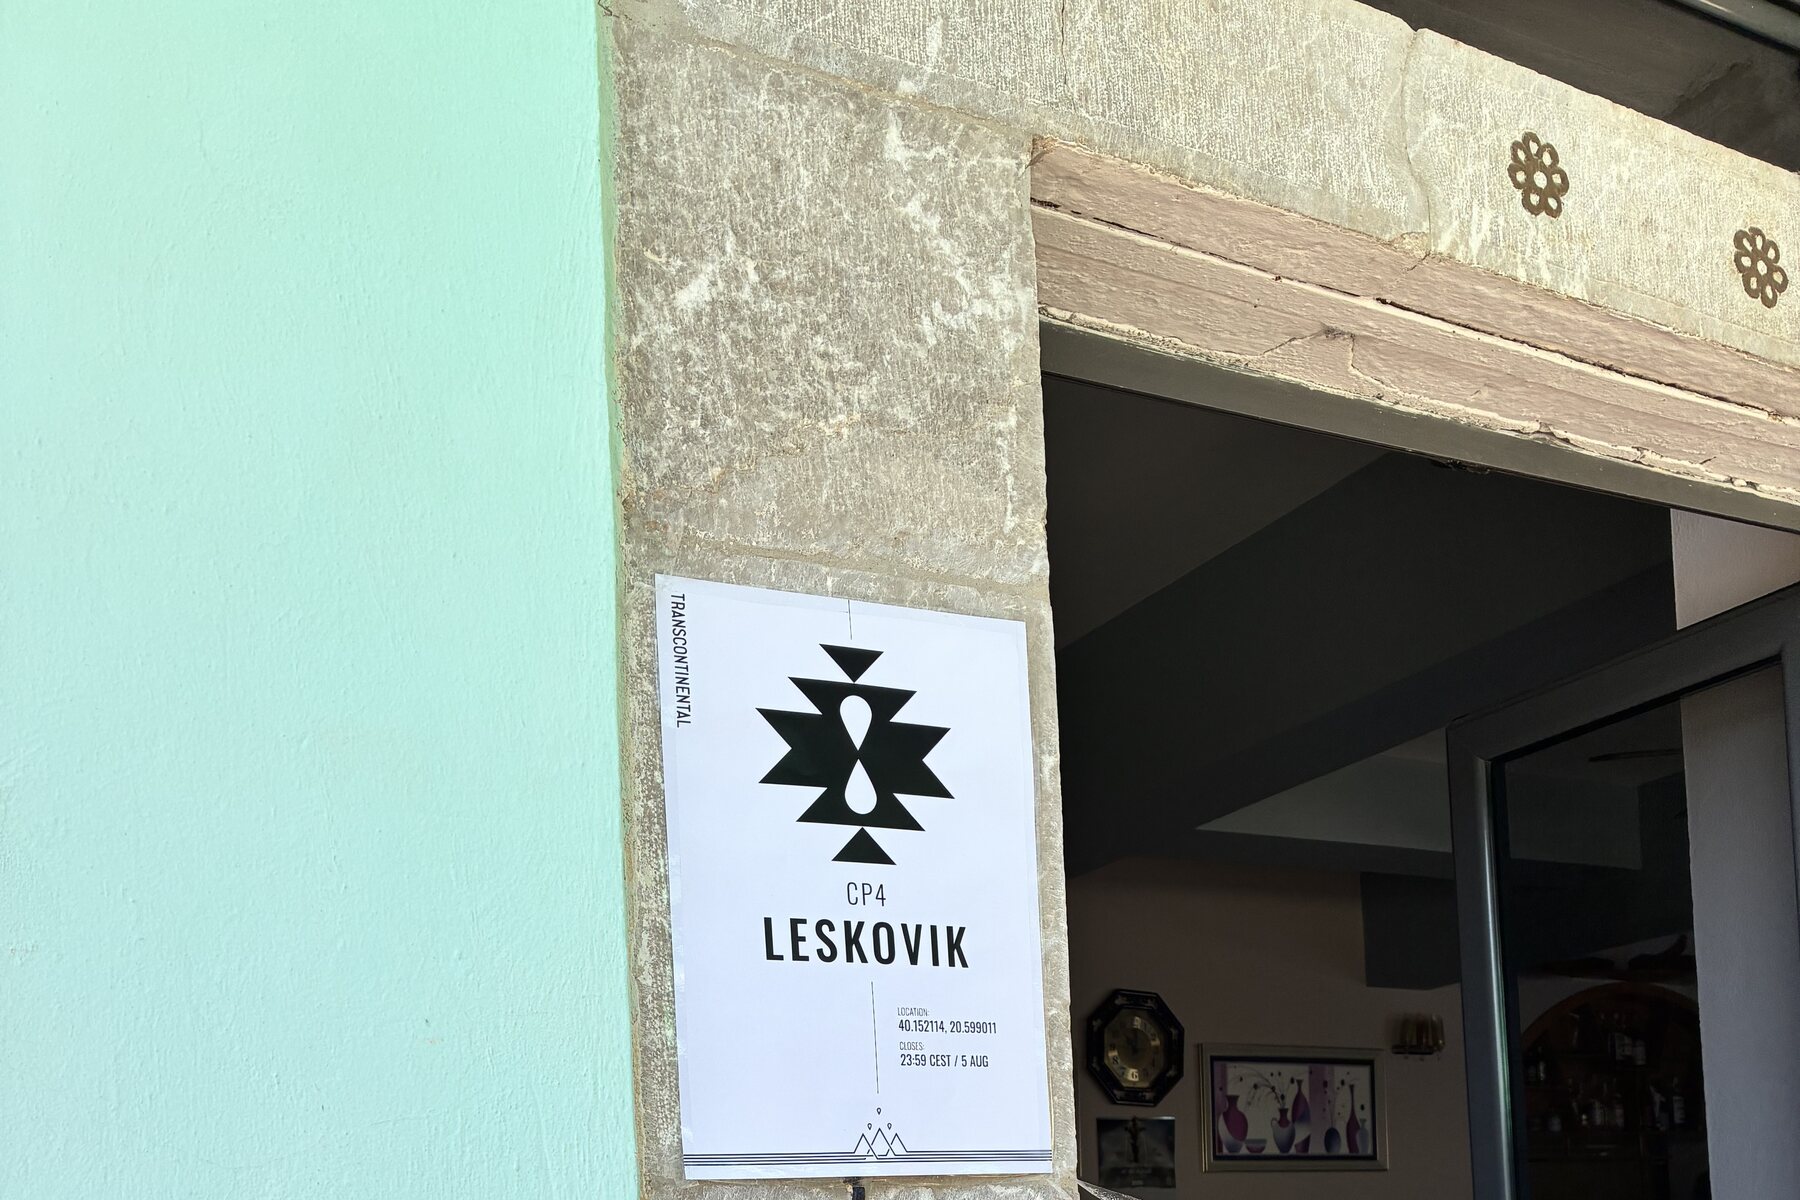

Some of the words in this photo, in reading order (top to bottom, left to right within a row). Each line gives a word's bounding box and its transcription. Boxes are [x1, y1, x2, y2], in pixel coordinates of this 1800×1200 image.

[670, 593, 692, 728] TRANSCONTINENTAL
[846, 881, 887, 907] CP4
[763, 916, 969, 969] LESKOVIK
[897, 1007, 930, 1017] LOCATION:
[898, 1019, 948, 1034] 40.152114,
[949, 1020, 997, 1034] 20.599011
[899, 1041, 925, 1051] CLOSES:
[900, 1053, 927, 1067] 23:59
[929, 1054, 951, 1067] CEST
[954, 1054, 959, 1067] /
[961, 1055, 968, 1067] 5
[969, 1055, 989, 1068] AUG
